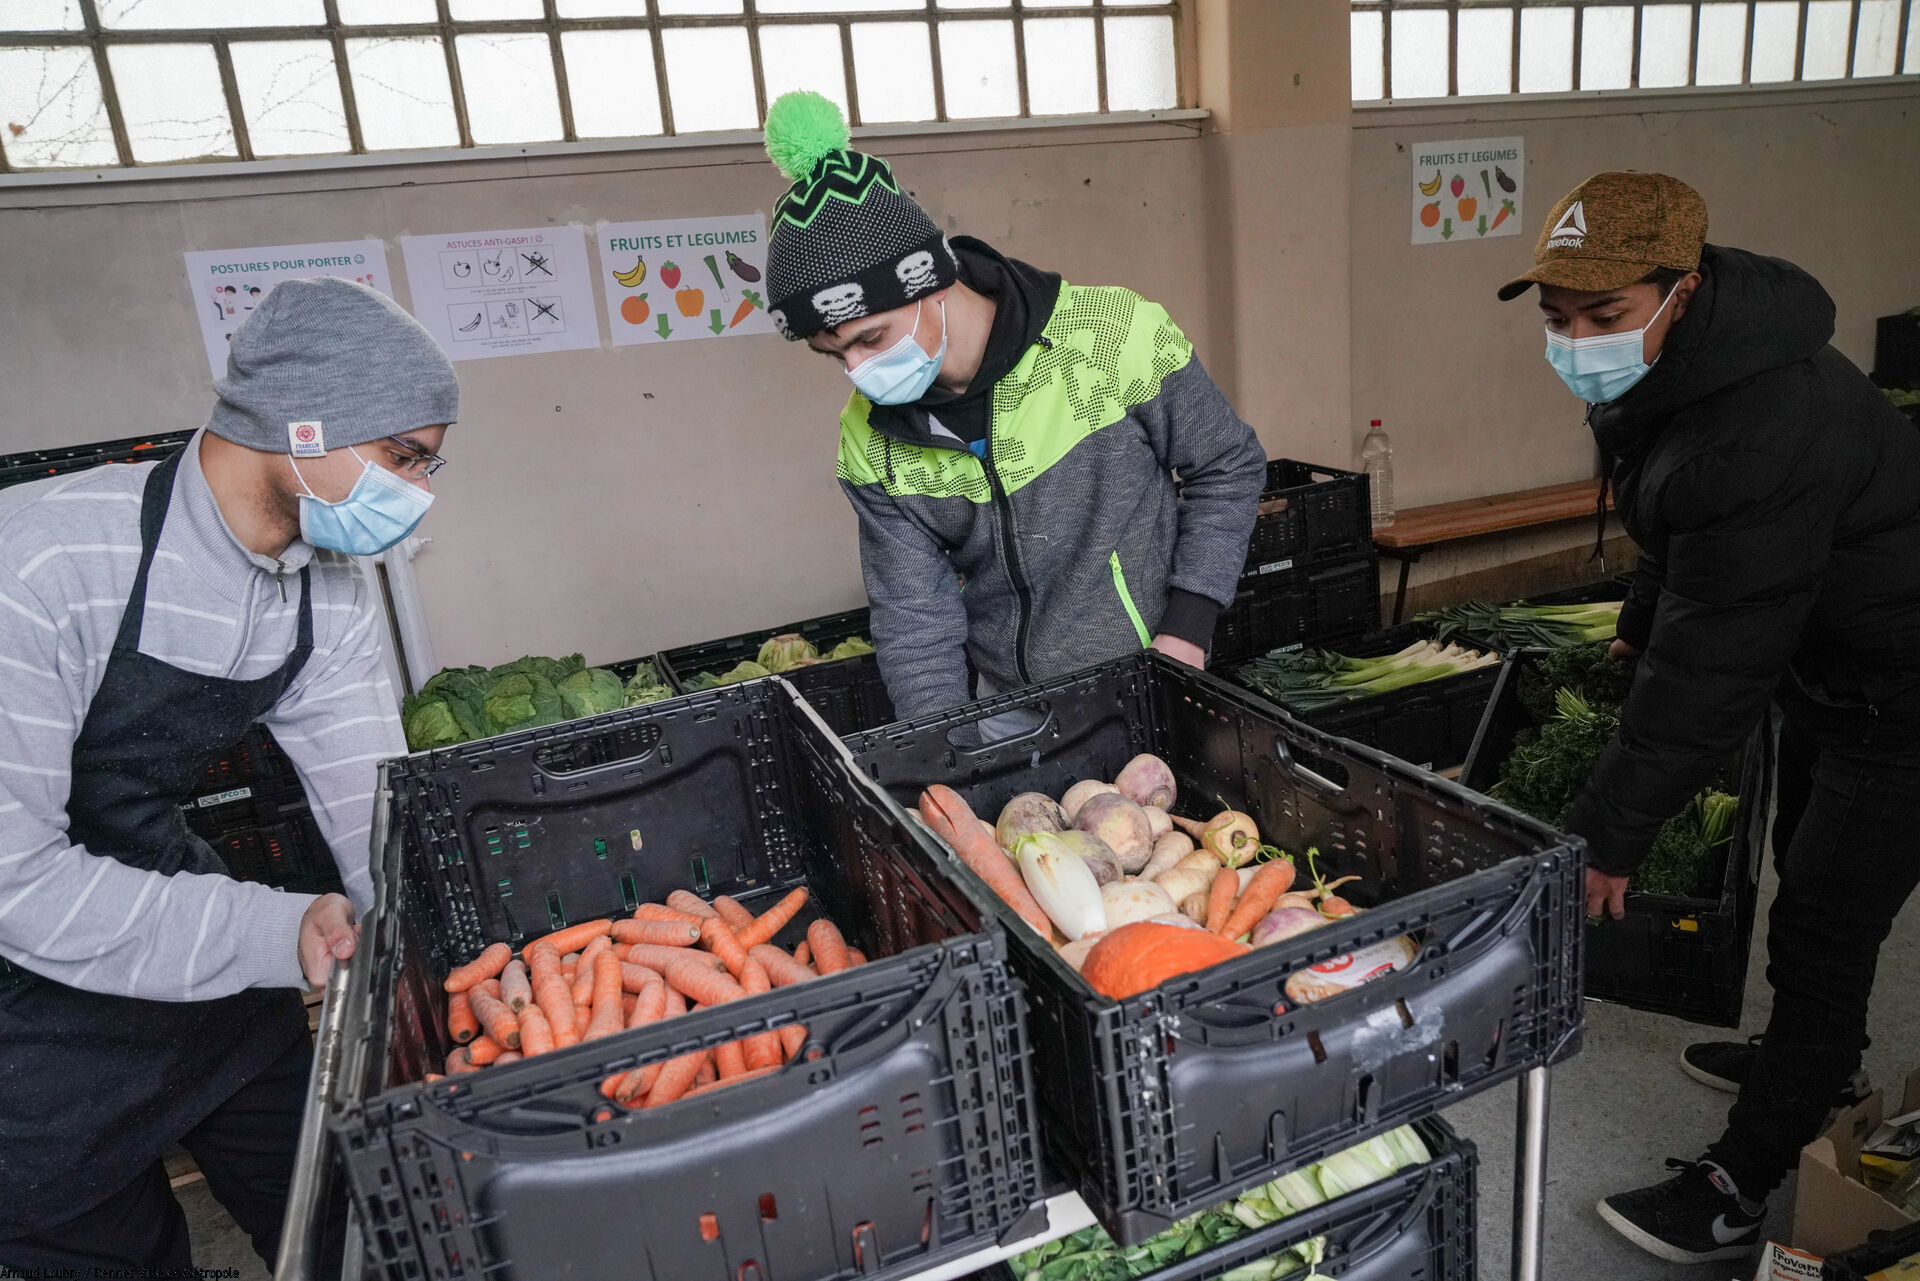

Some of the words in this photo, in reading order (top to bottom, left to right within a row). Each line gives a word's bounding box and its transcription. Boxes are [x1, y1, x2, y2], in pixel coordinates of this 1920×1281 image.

[1419, 153, 1456, 166] FRUITS
[1457, 152, 1469, 164] ET
[1471, 148, 1518, 163] LEGUMES
[446, 240, 482, 249] ASTUCES
[484, 237, 529, 247] ANTI-GASPI
[609, 235, 663, 252] FRUITS
[666, 234, 683, 248] ET
[687, 230, 757, 247] LEGUMES
[1546, 236, 1584, 250] Reebok
[210, 261, 270, 275] POSTURES
[272, 258, 305, 271] POUR
[308, 255, 352, 268] PORTER
[221, 789, 240, 799] IFCO
